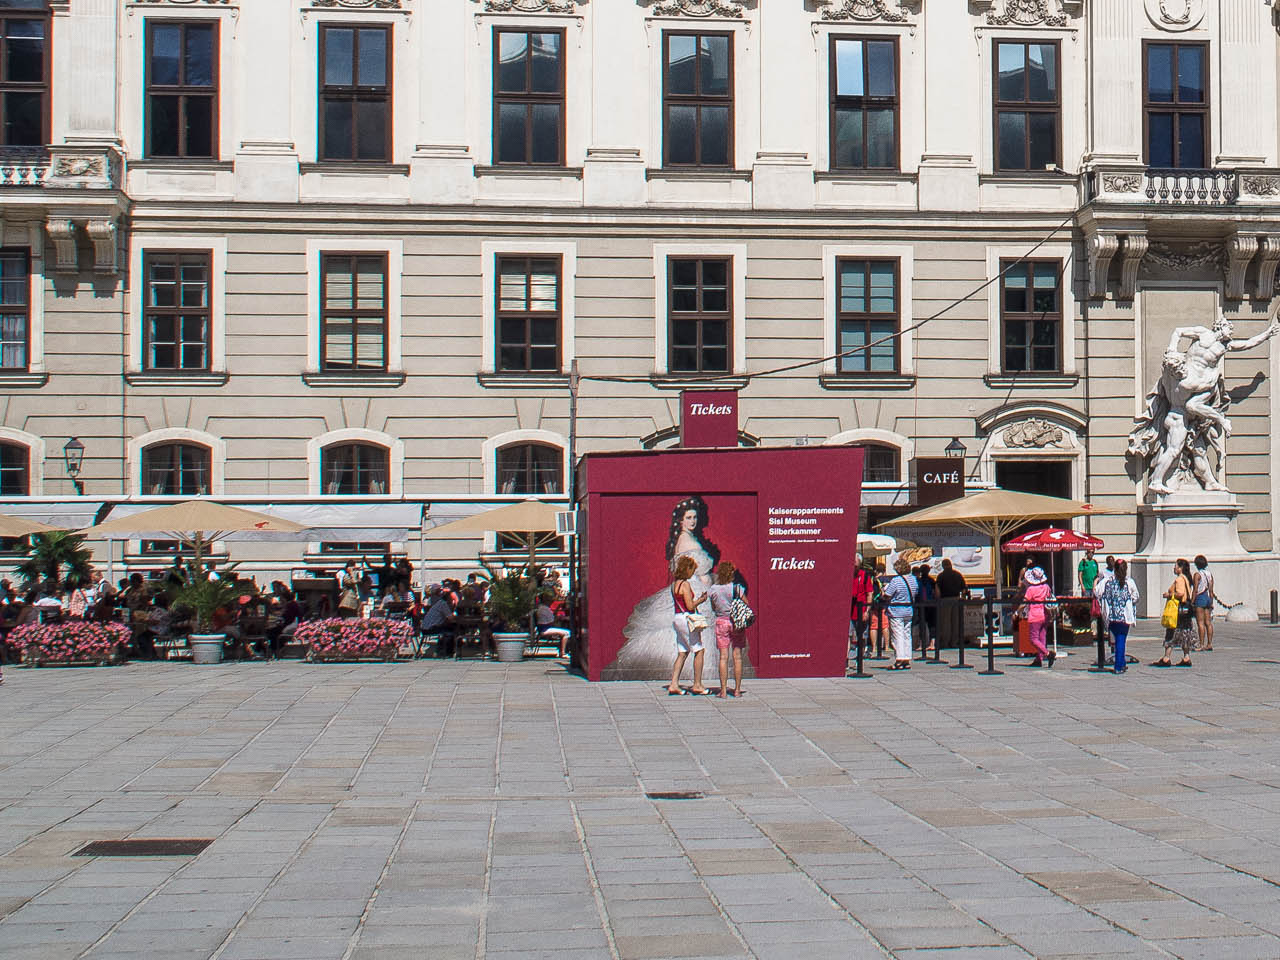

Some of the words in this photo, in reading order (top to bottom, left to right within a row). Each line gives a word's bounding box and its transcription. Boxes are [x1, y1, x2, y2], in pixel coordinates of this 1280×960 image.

[690, 403, 732, 415] Tickets
[923, 470, 959, 484] CAFÉ
[768, 507, 844, 516] Kaiserappartements
[768, 517, 783, 525] Sisi
[785, 517, 817, 525] Museum
[770, 557, 815, 570] Tickets
